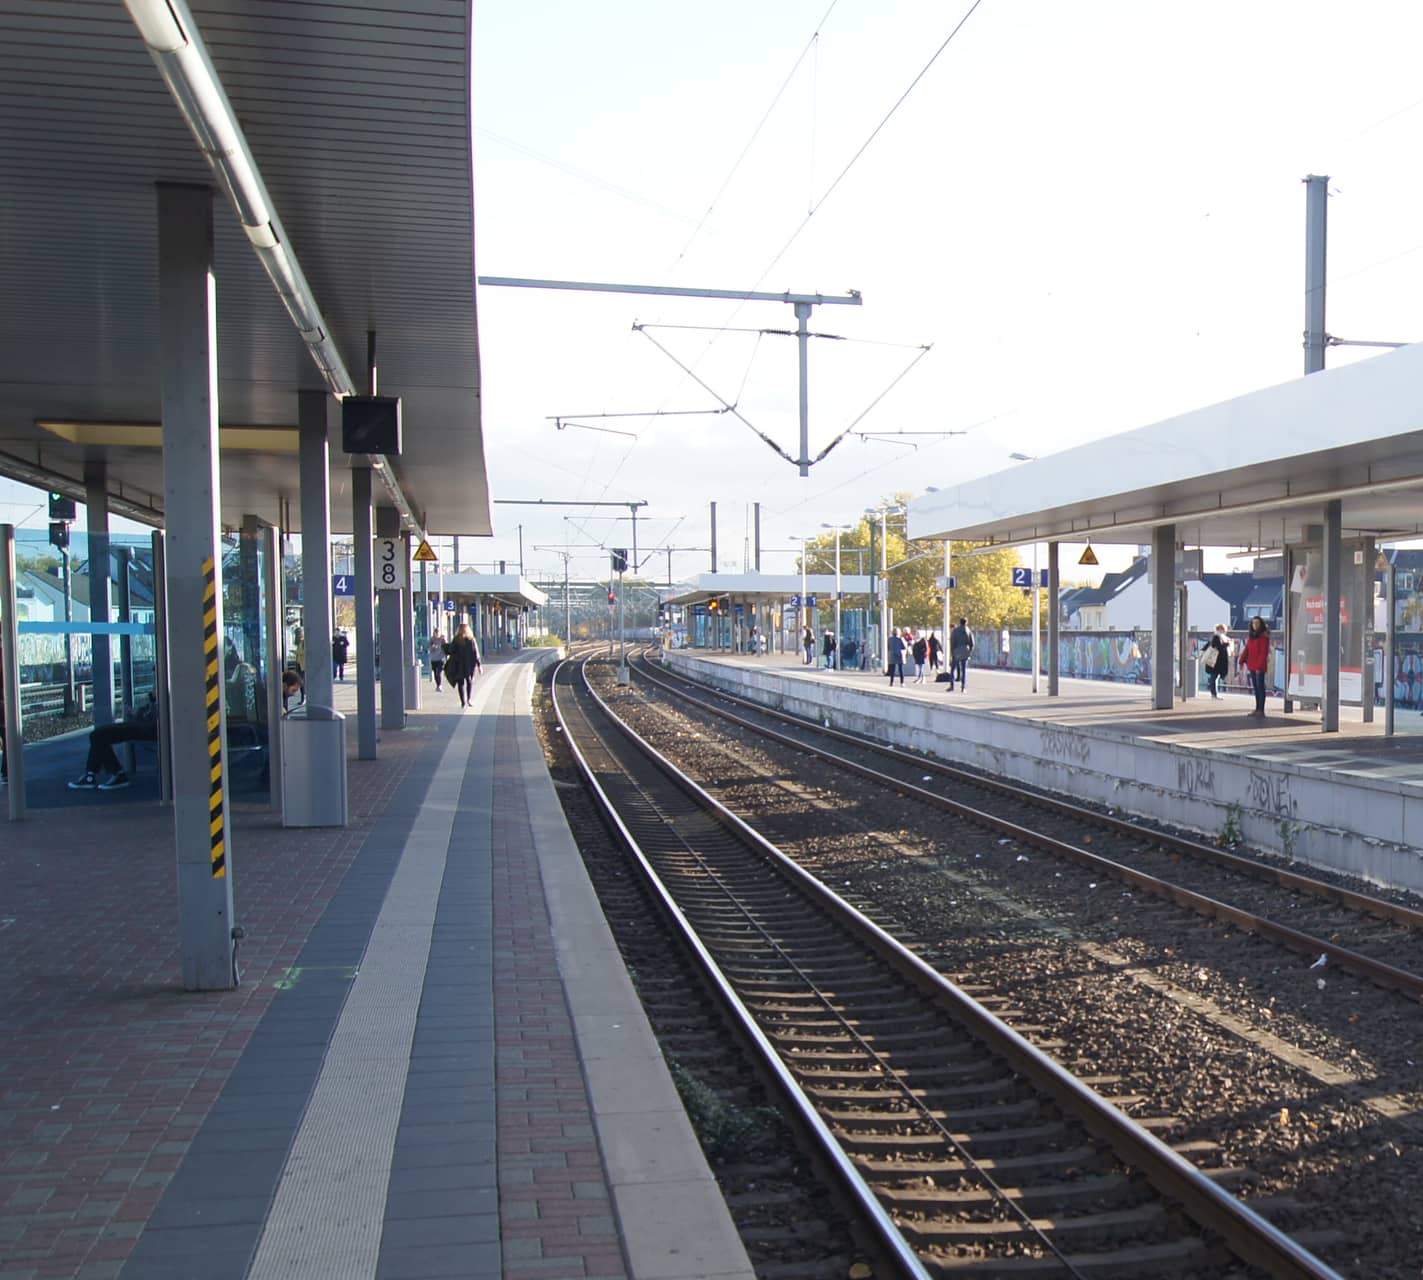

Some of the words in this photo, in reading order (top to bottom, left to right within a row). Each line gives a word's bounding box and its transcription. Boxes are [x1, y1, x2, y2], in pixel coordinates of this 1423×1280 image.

[382, 541, 395, 561] 3
[382, 563, 396, 584] 8
[1015, 569, 1026, 584] 2
[336, 576, 348, 593] 4
[447, 600, 456, 610] 3
